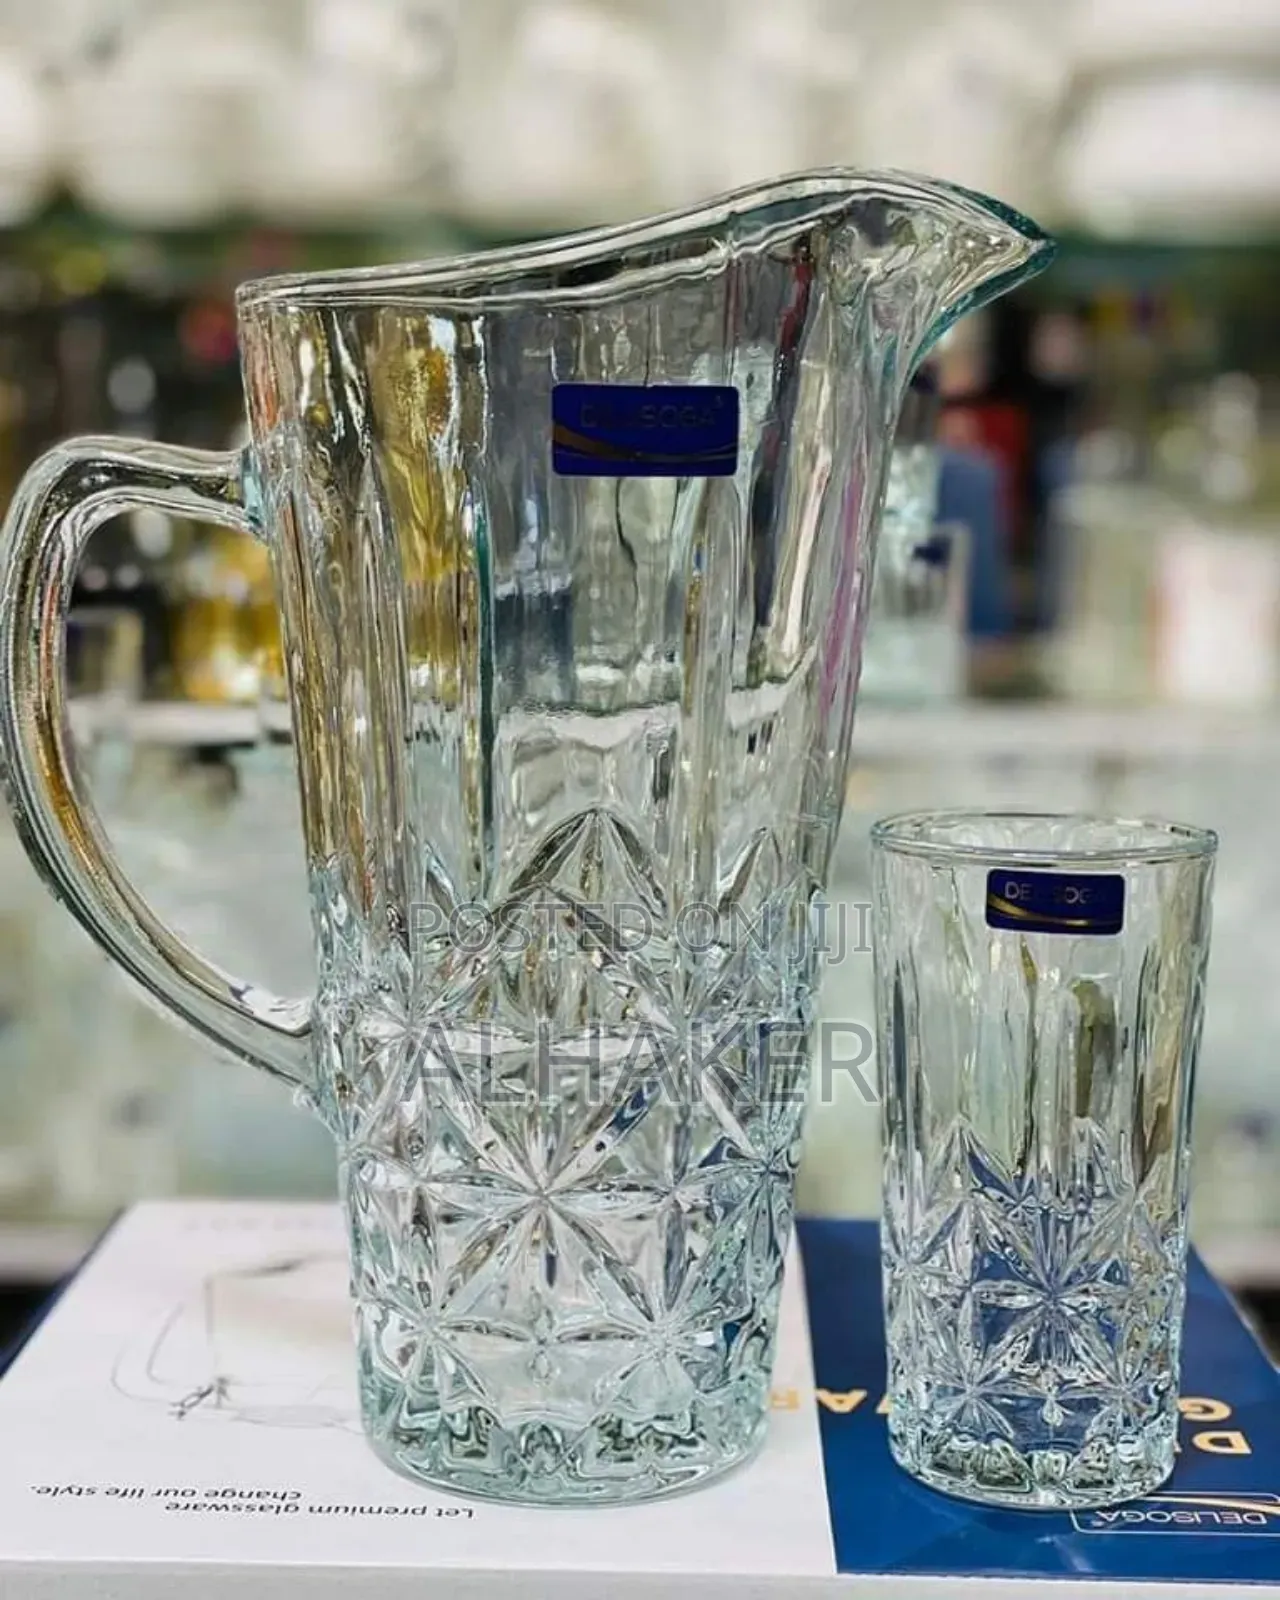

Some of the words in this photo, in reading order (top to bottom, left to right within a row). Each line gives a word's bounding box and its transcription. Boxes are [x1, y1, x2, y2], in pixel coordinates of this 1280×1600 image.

[580, 403, 716, 428] DSOGA
[30, 1484, 97, 1496] style.
[105, 1486, 145, 1498] life
[151, 1488, 197, 1498] our
[204, 1487, 301, 1501] change
[165, 1502, 300, 1515] glassware
[308, 1504, 427, 1516] premium
[435, 1506, 473, 1518] Let
